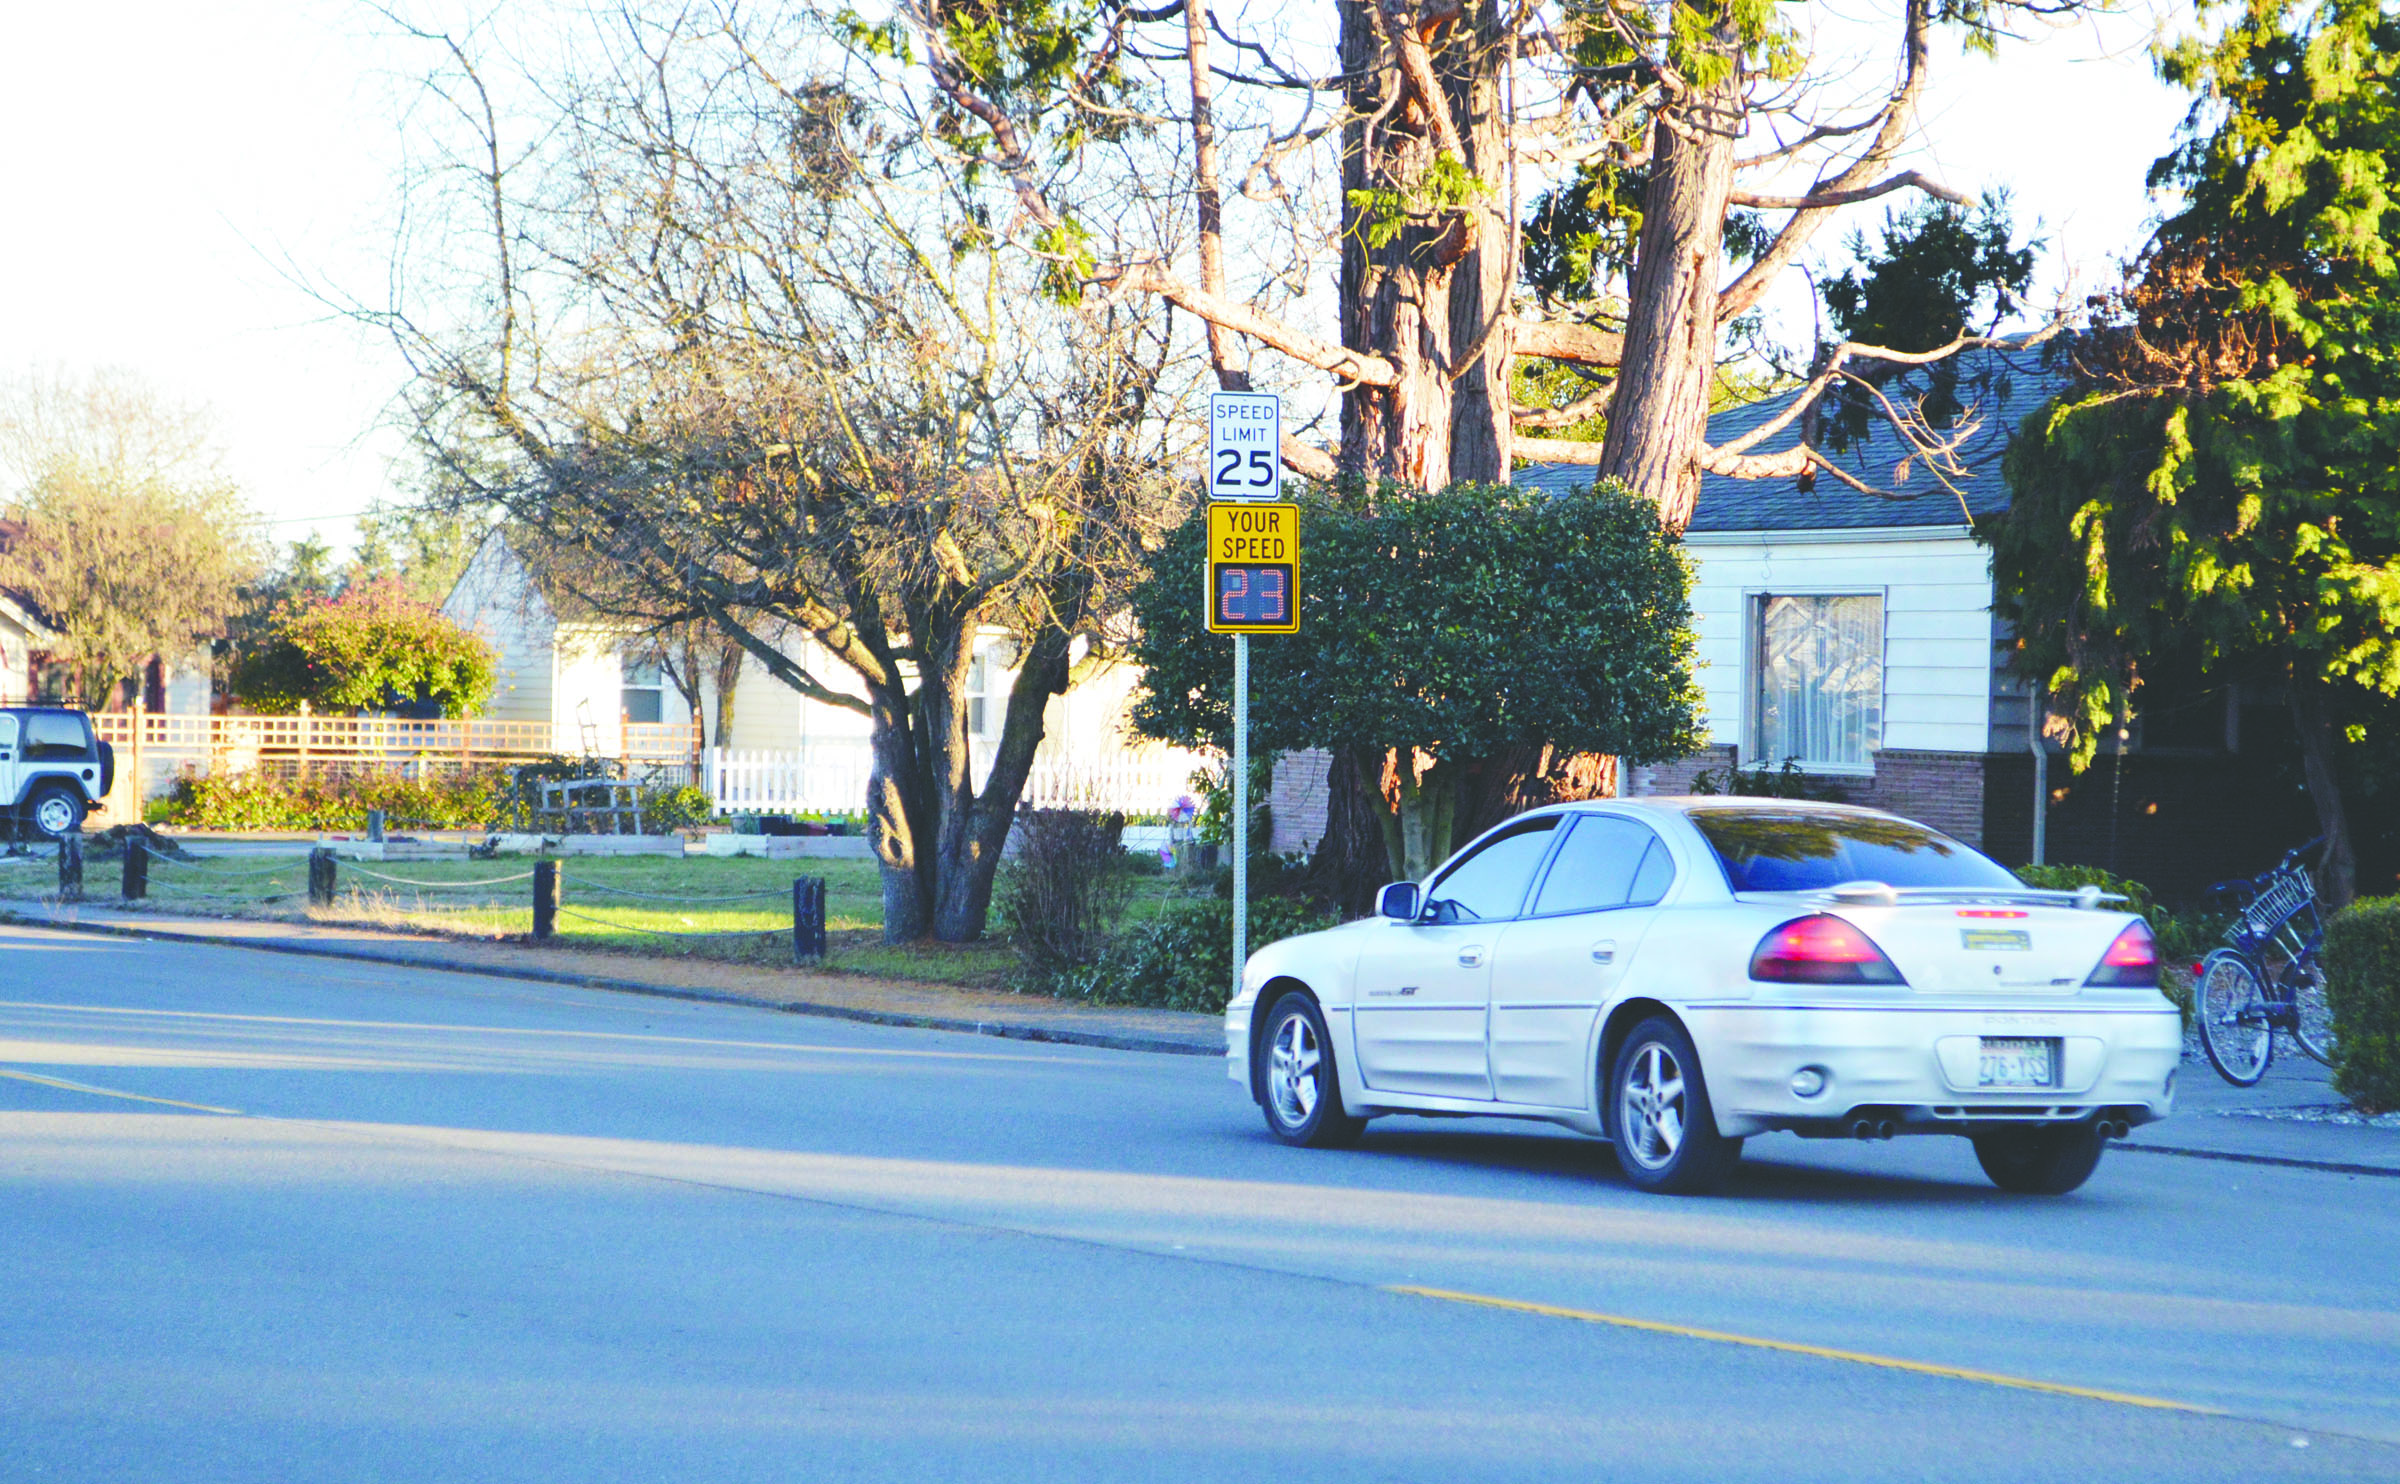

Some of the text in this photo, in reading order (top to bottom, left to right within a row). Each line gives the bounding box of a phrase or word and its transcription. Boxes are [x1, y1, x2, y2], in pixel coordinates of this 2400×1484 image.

[1216, 404, 1274, 420] SPEED
[1222, 428, 1266, 441] LIMIT
[1216, 449, 1273, 487] 25
[1227, 511, 1280, 533] YOUR
[1223, 537, 1284, 559] SPEED
[1222, 569, 1284, 619] 23
[1984, 1016, 2057, 1026] PONTIAC
